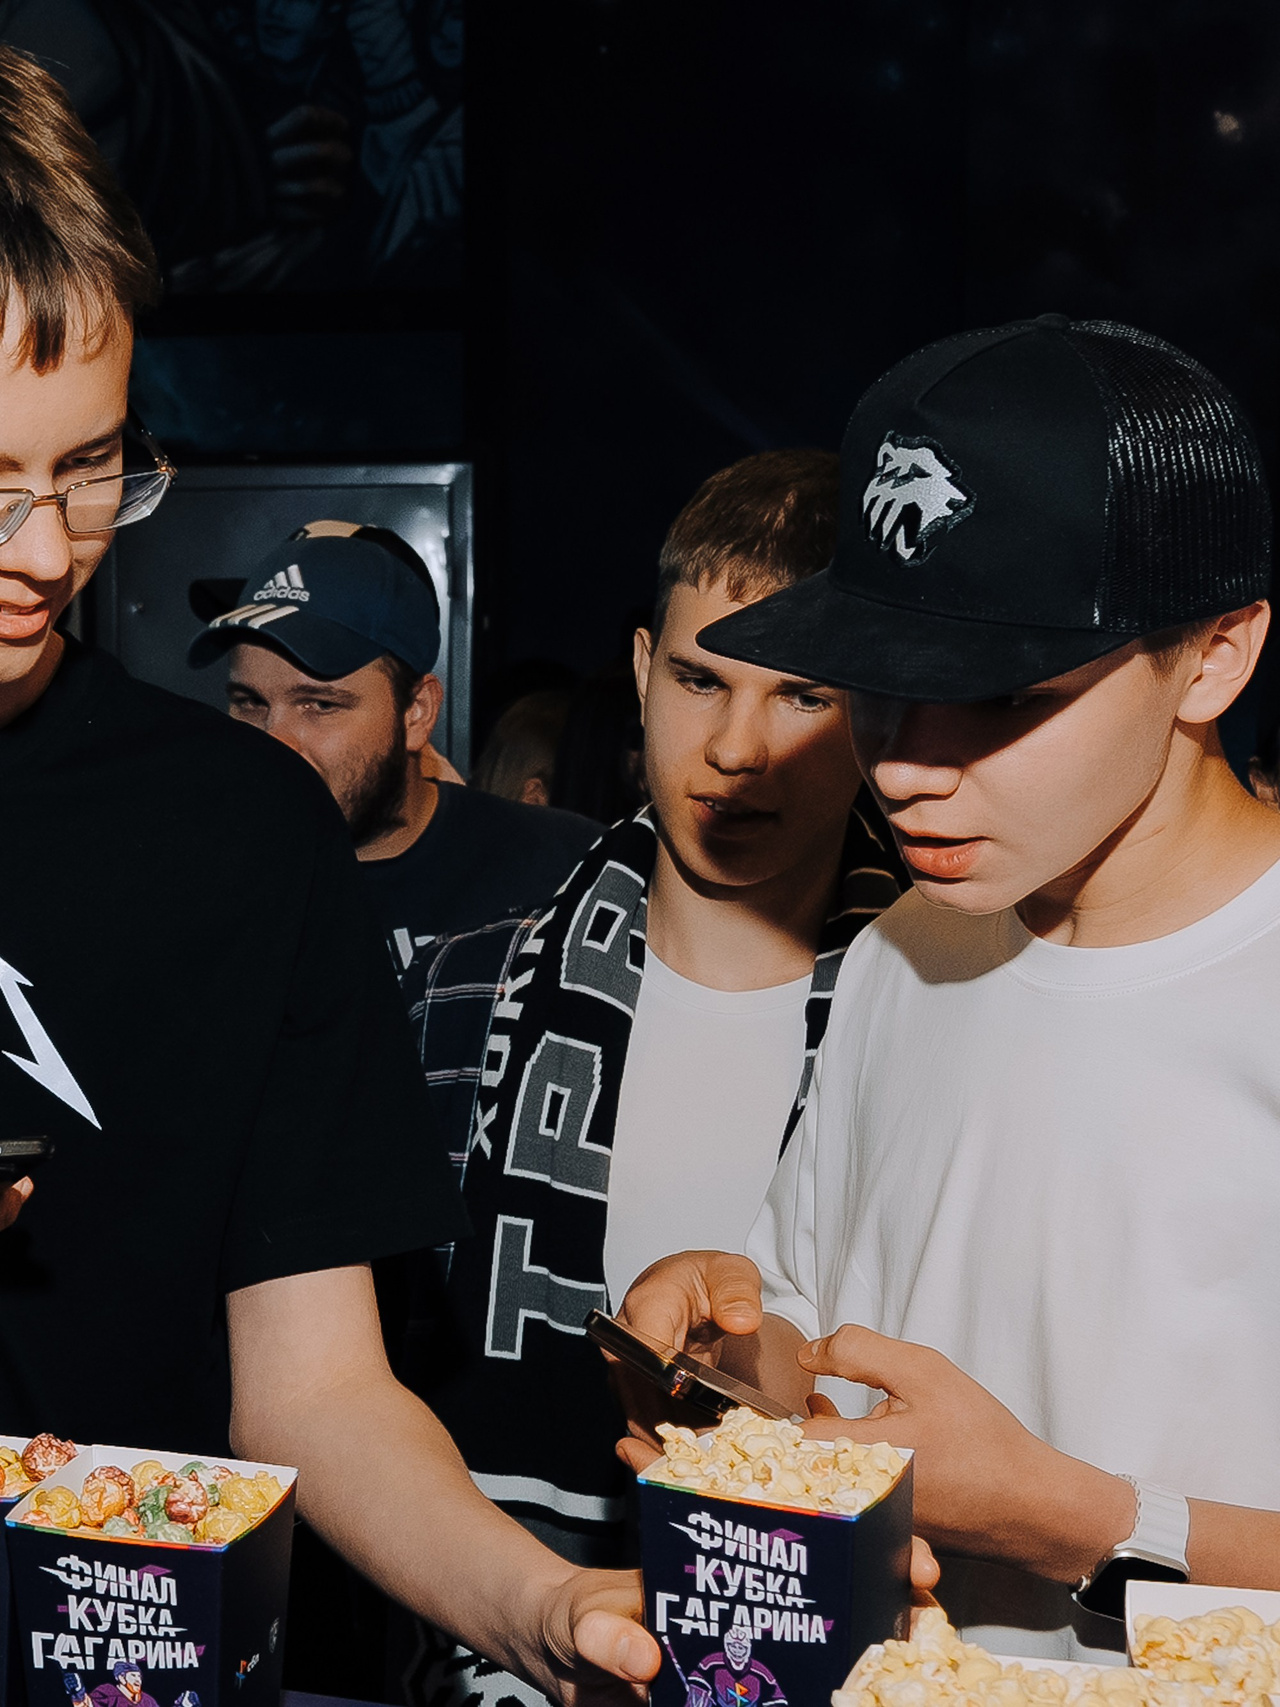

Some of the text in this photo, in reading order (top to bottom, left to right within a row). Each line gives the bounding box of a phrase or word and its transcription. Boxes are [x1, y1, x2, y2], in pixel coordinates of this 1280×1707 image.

[253, 585, 310, 602] adidas
[668, 1511, 807, 1575] ФИНАЛ
[38, 1554, 177, 1606] ФИНАЛ
[696, 1554, 816, 1608] КУБКА
[67, 1595, 188, 1637] КУБКА
[656, 1591, 827, 1644] ГАГАРИНА
[31, 1631, 199, 1671] ГАГАРИНА
